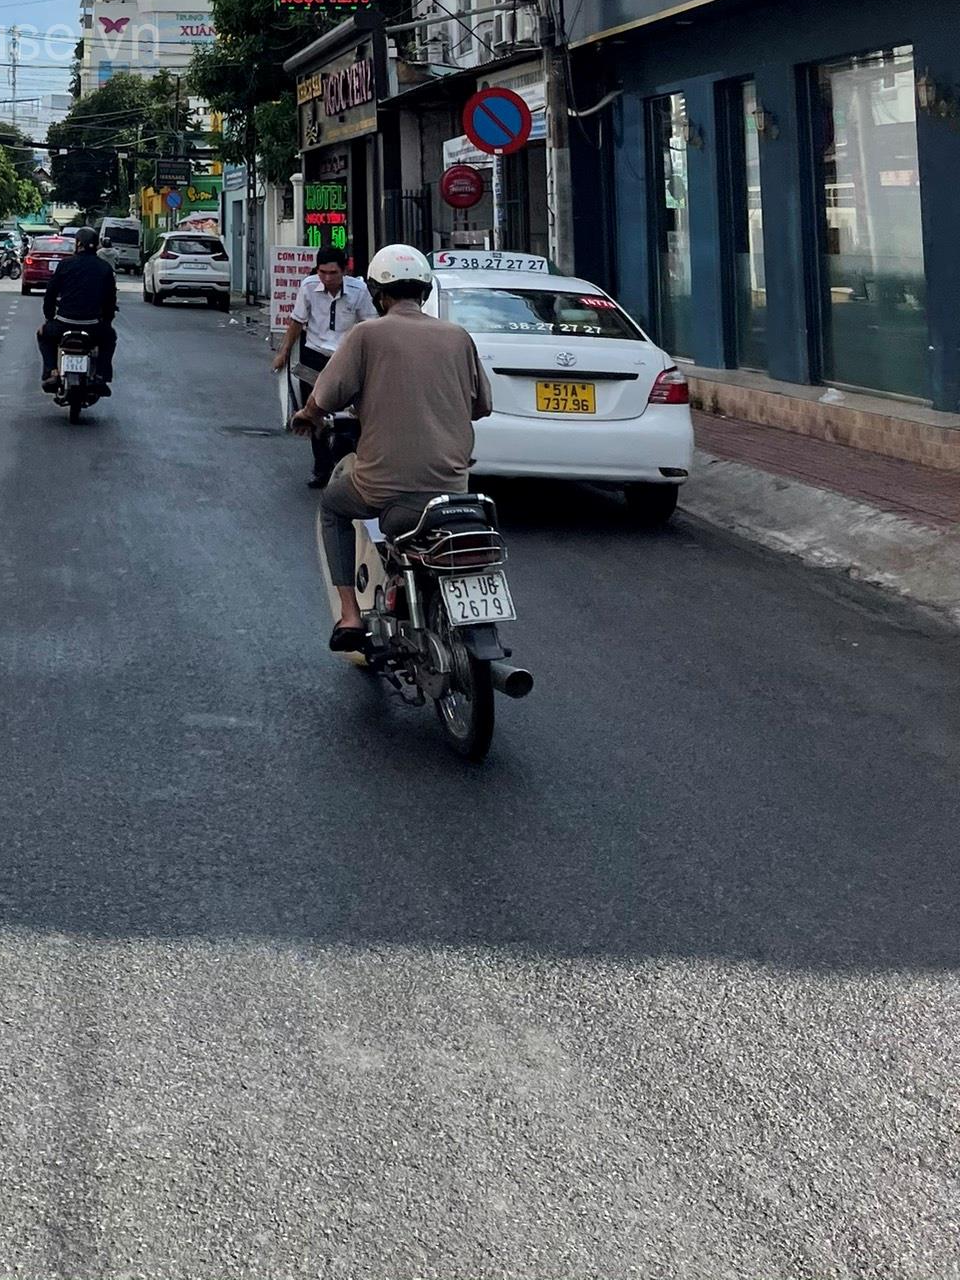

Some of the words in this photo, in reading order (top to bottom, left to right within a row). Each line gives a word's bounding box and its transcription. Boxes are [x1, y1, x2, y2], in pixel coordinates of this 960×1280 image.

[305, 185, 346, 210] HOTEL
[460, 259, 501, 269] 38.27
[506, 260, 523, 269] 27
[527, 260, 545, 270] 27
[509, 322, 554, 331] 38.27
[559, 324, 578, 332] 27
[583, 325, 601, 334] 27
[552, 384, 578, 398] 51A
[543, 398, 589, 412] 737.96
[458, 597, 503, 619] 2679
